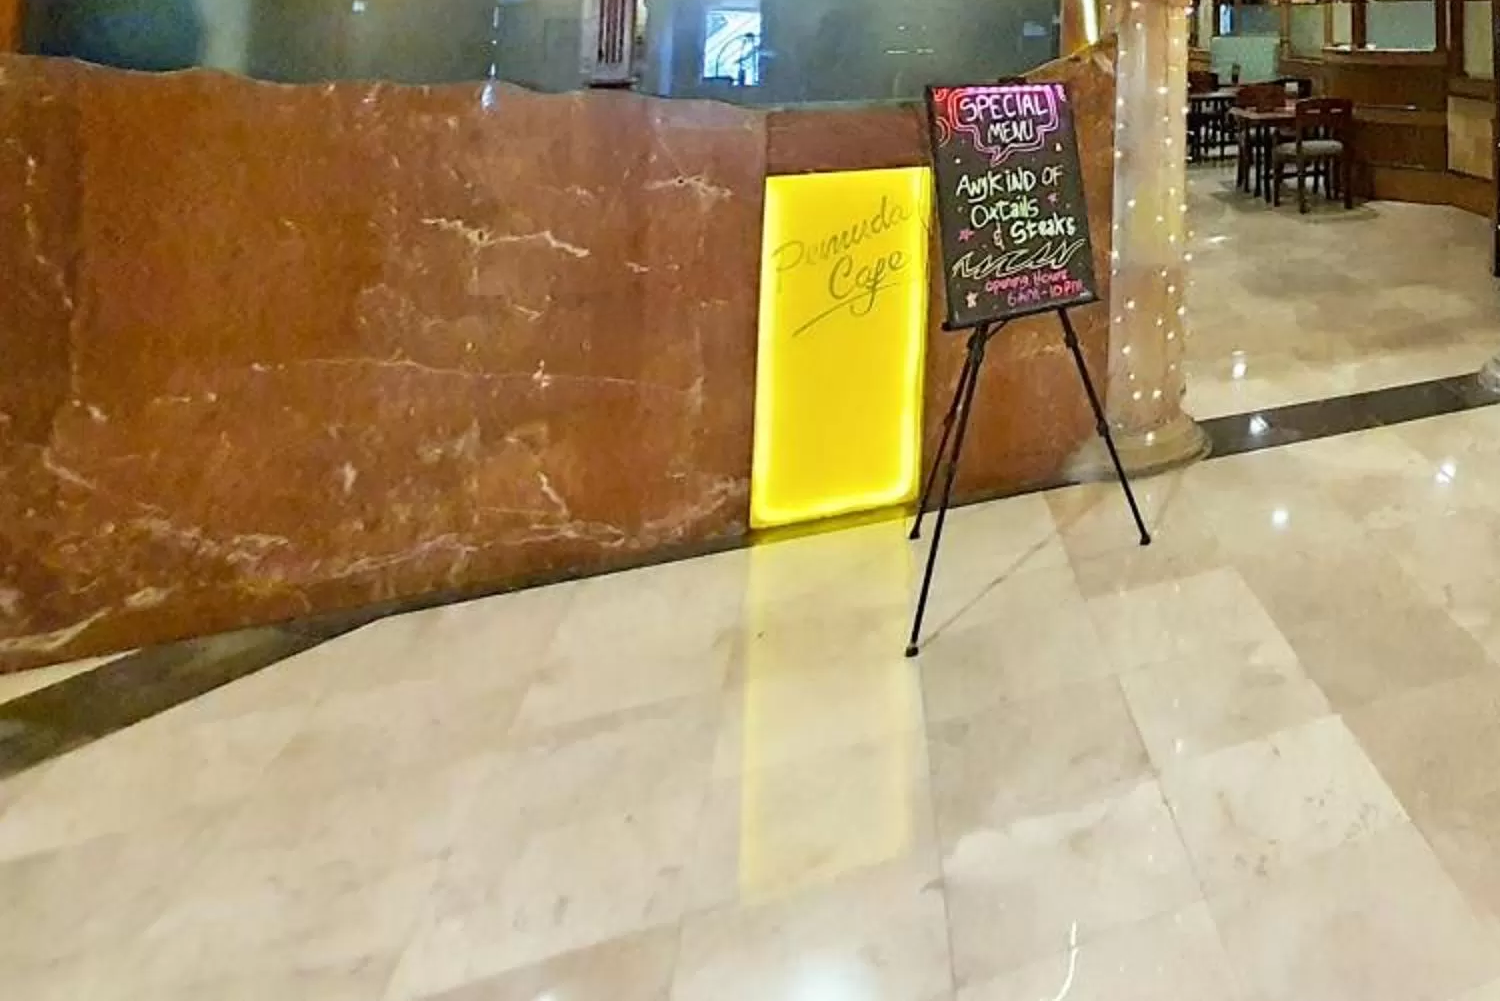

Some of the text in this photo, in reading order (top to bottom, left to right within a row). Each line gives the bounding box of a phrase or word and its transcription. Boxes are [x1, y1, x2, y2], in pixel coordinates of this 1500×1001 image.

[959, 92, 1048, 122] SPECIAL
[987, 119, 1034, 144] MENU
[1041, 165, 1064, 186] OF
[1009, 212, 1077, 244] Steaks
[771, 194, 913, 296] Pemuda
